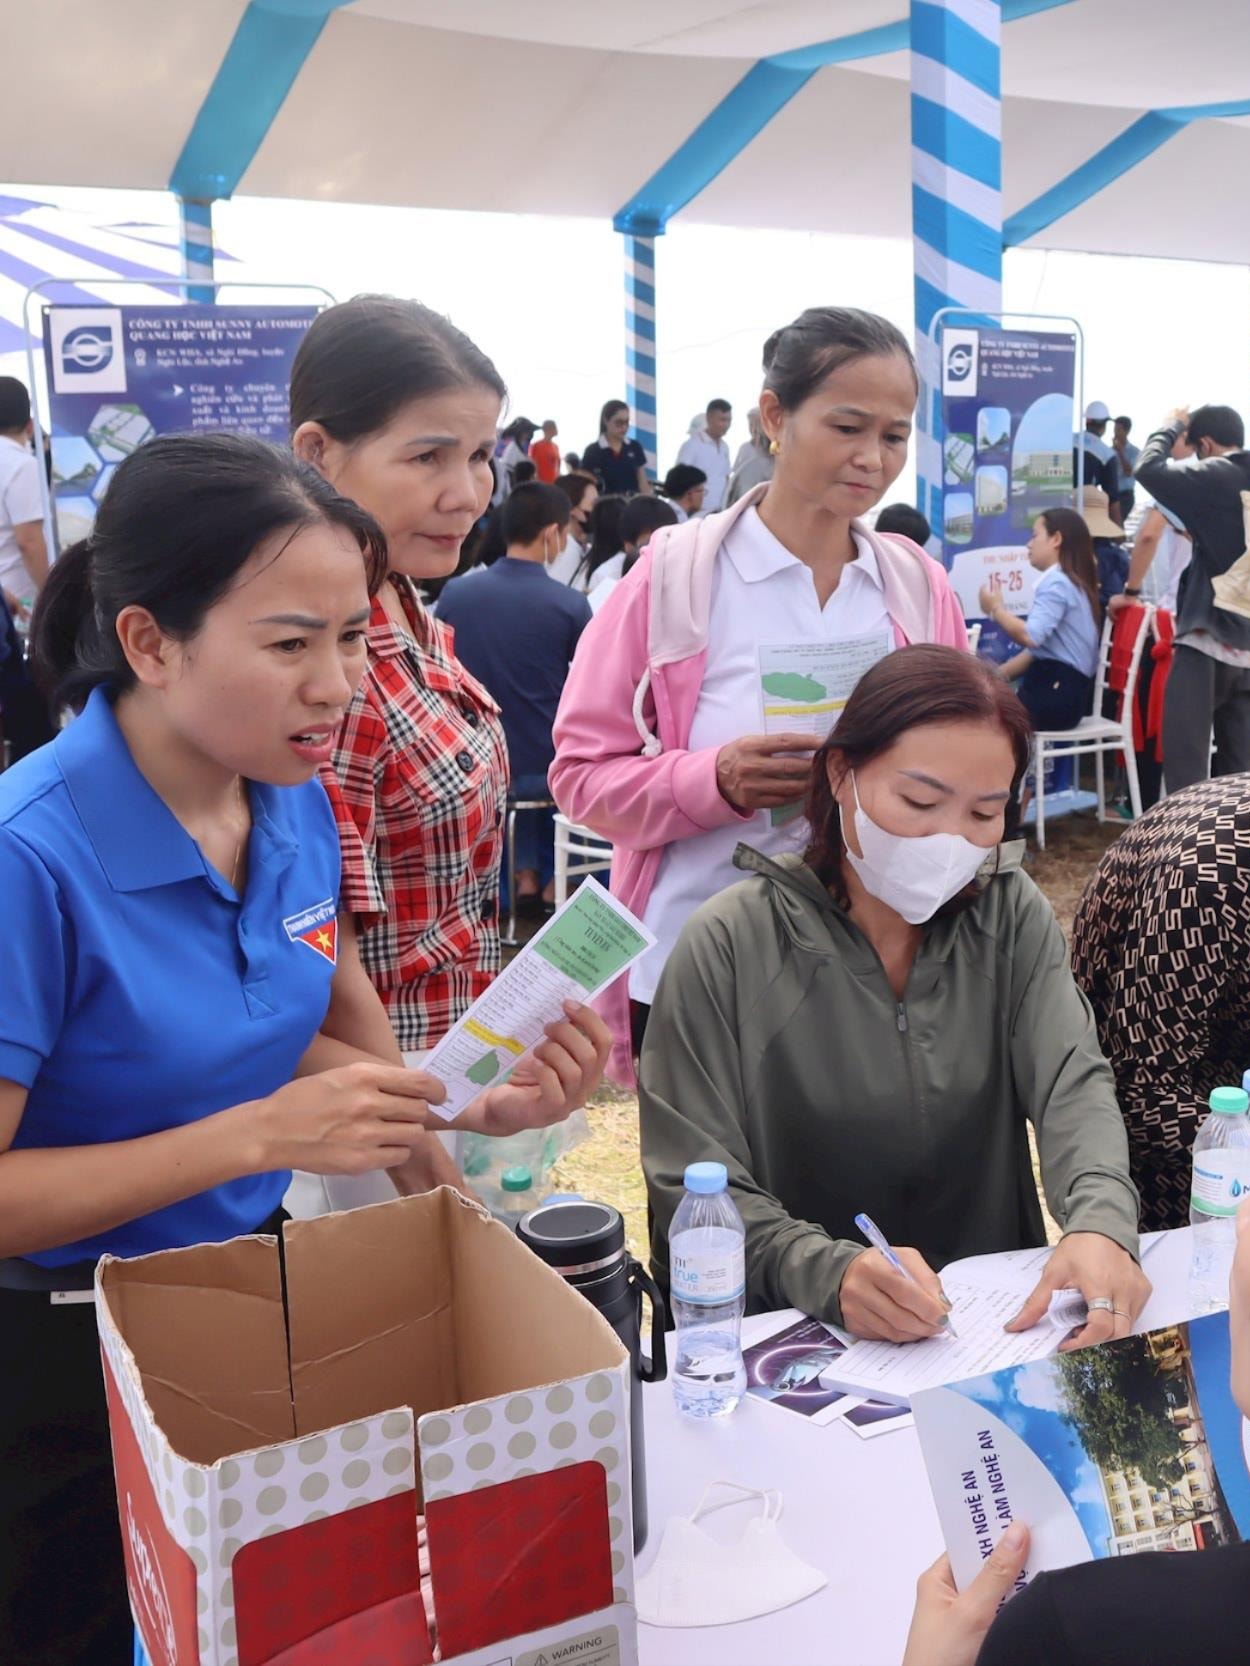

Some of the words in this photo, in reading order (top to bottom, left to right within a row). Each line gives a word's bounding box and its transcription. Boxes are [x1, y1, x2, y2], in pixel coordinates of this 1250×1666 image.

[129, 318, 161, 329] CÔNG
[165, 319, 178, 329] TY
[129, 331, 170, 341] QUANG
[200, 328, 223, 341] VIỆT
[226, 331, 252, 340] NAM
[673, 1267, 699, 1283] true
[977, 1429, 995, 1450] AN
[961, 1470, 978, 1490] AN
[980, 1453, 1006, 1494] NGHỆ
[964, 1493, 989, 1535] NGHỆ
[995, 1496, 1014, 1529] ÀM
[978, 1538, 994, 1559] XH
[552, 1637, 602, 1660] WARNING
